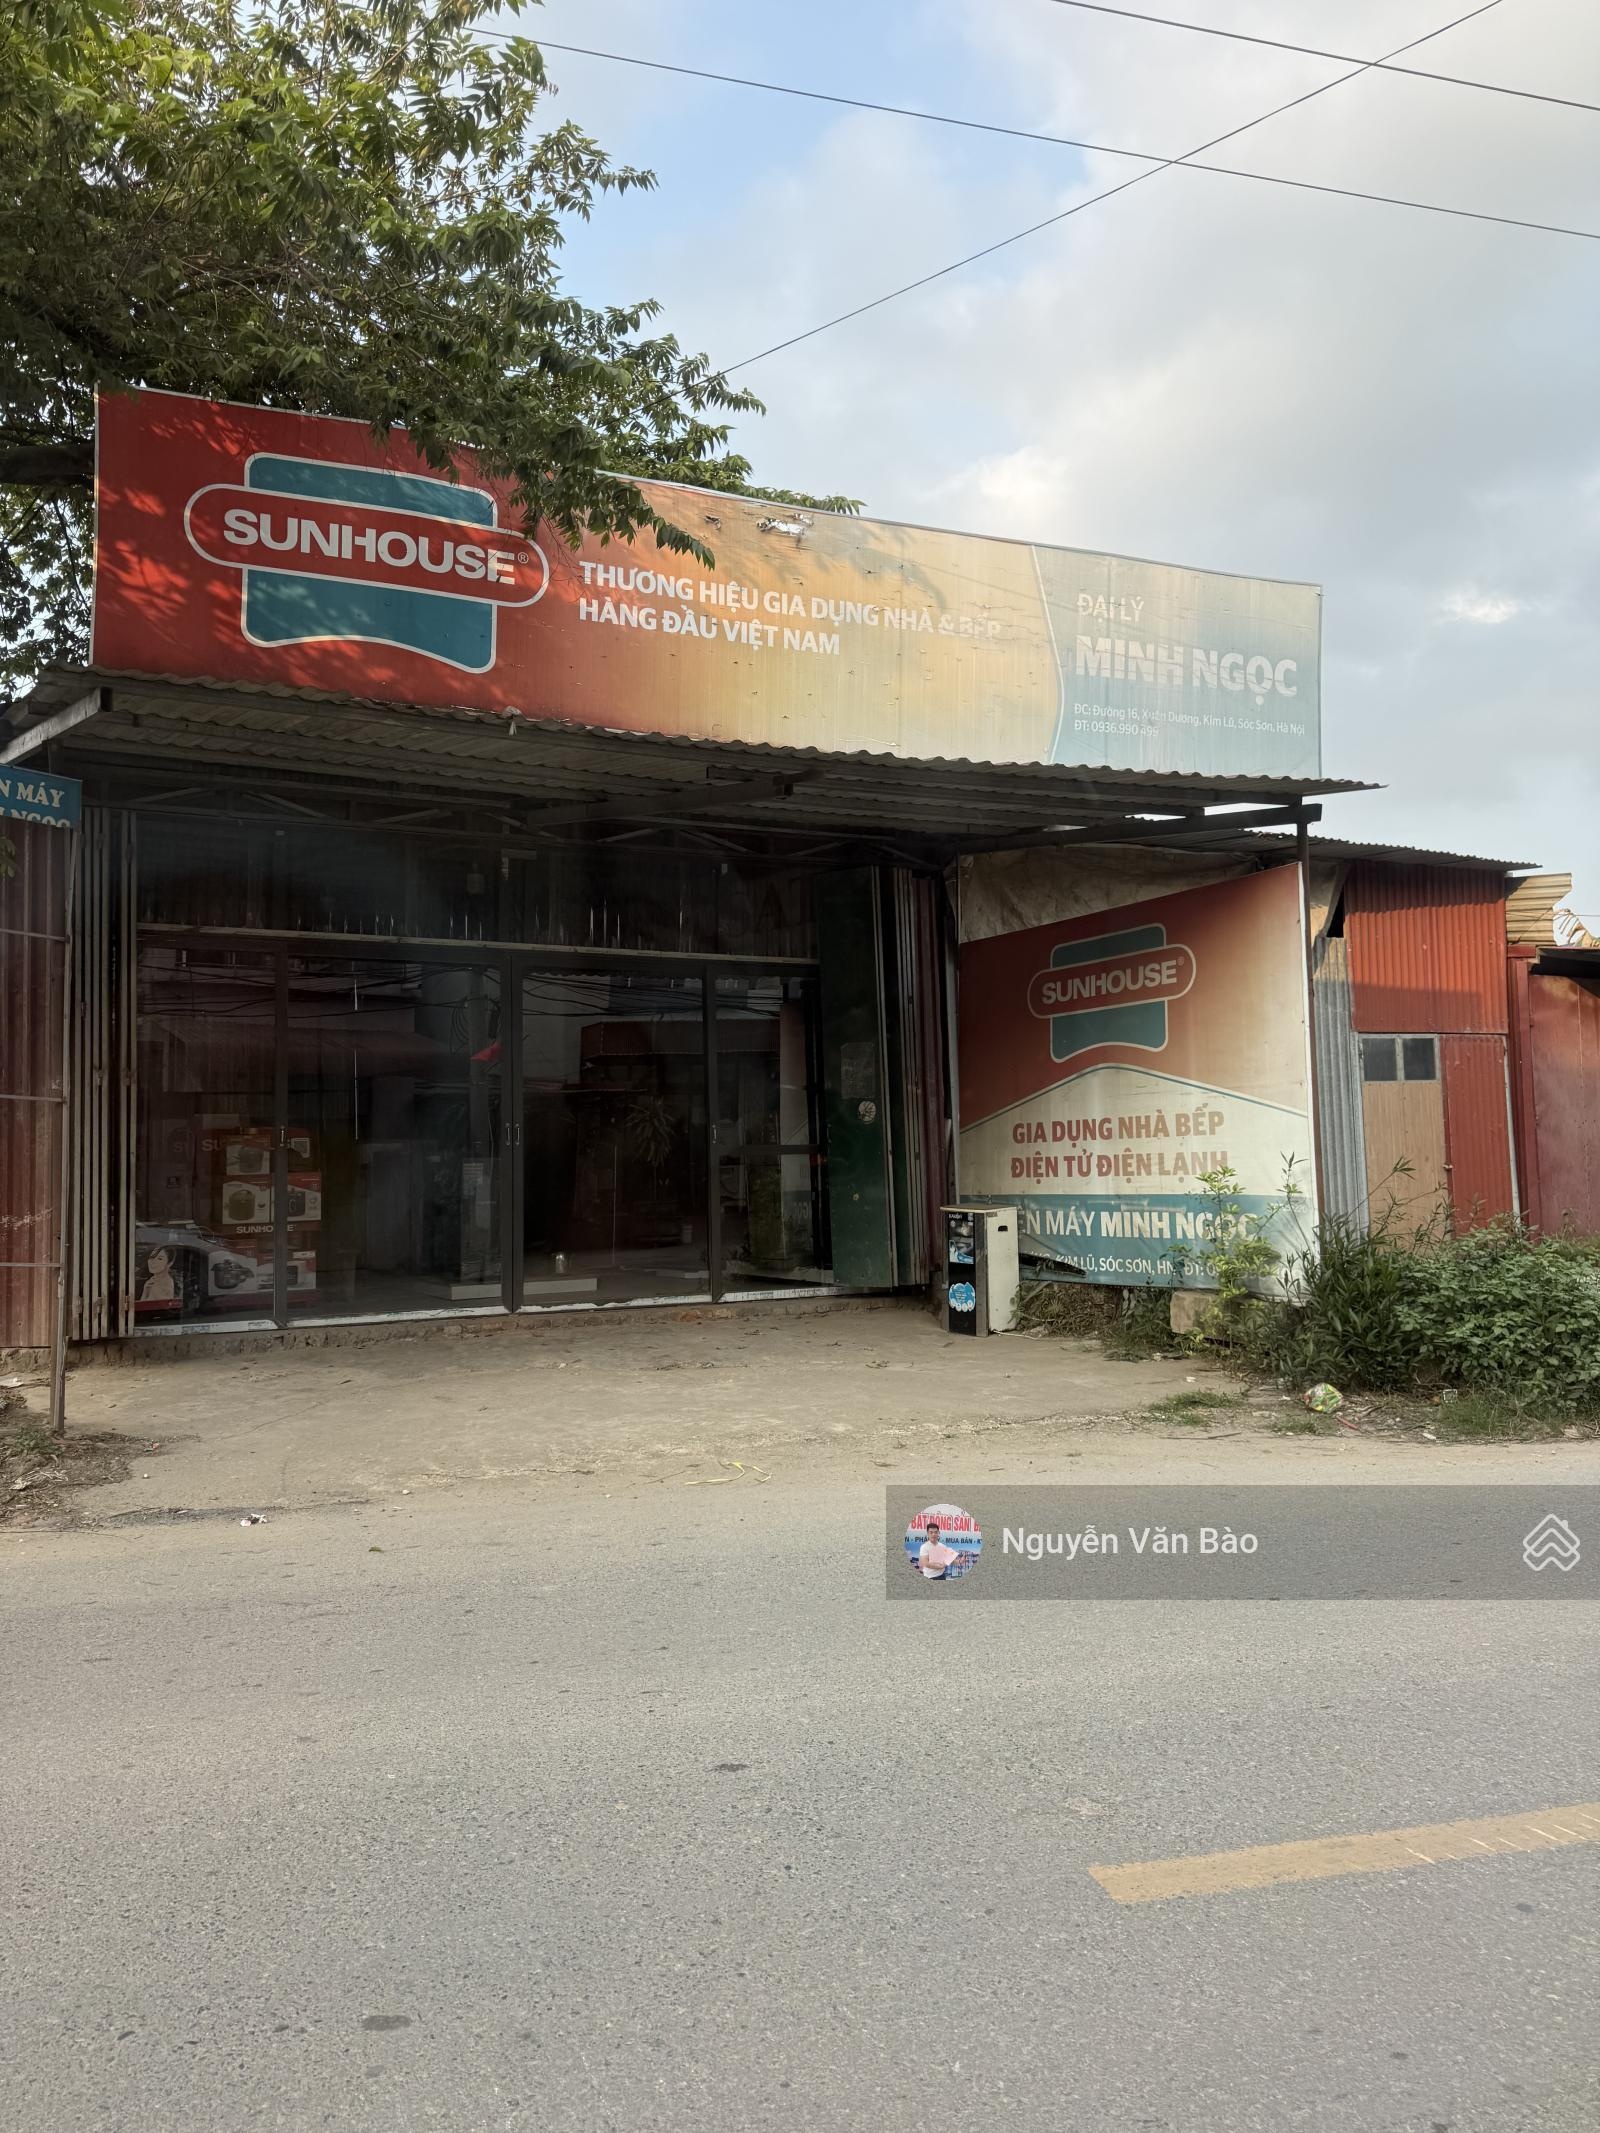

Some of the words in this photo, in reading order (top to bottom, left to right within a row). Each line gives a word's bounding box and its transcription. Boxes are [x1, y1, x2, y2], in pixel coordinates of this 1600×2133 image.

[579, 560, 694, 601] THƯƠNG
[699, 580, 759, 613] HIỆU
[763, 591, 806, 618] GIA
[811, 597, 879, 627] DỤNG
[883, 607, 934, 633] NHÀ
[1076, 593, 1115, 622] ĐẠI
[1120, 596, 1145, 622] LÝ
[579, 597, 657, 631] HÀNG
[661, 604, 718, 640] ĐẦU
[722, 619, 779, 651] VIỆT
[783, 627, 840, 656] NAM
[1075, 635, 1185, 689] MINH
[1191, 648, 1298, 706] NGỌC
[16, 781, 65, 808] MÁY
[1012, 1122, 1047, 1144] GIA
[1051, 1117, 1113, 1148] DỤNG
[1118, 1109, 1170, 1140] NHÀ
[1175, 1102, 1225, 1137] BẾP
[1010, 1150, 1059, 1184] ĐIỆN
[1063, 1148, 1094, 1178] TỬ
[1096, 1147, 1152, 1184] ĐIỆN
[1158, 1150, 1228, 1183] LẠNH
[235, 1223, 296, 1234] SUNHOE
[1046, 1206, 1096, 1238] MÁY
[1100, 1211, 1171, 1239] MINH
[1099, 1255, 1124, 1272] SÓC
[1125, 1257, 1155, 1276] SƠN,
